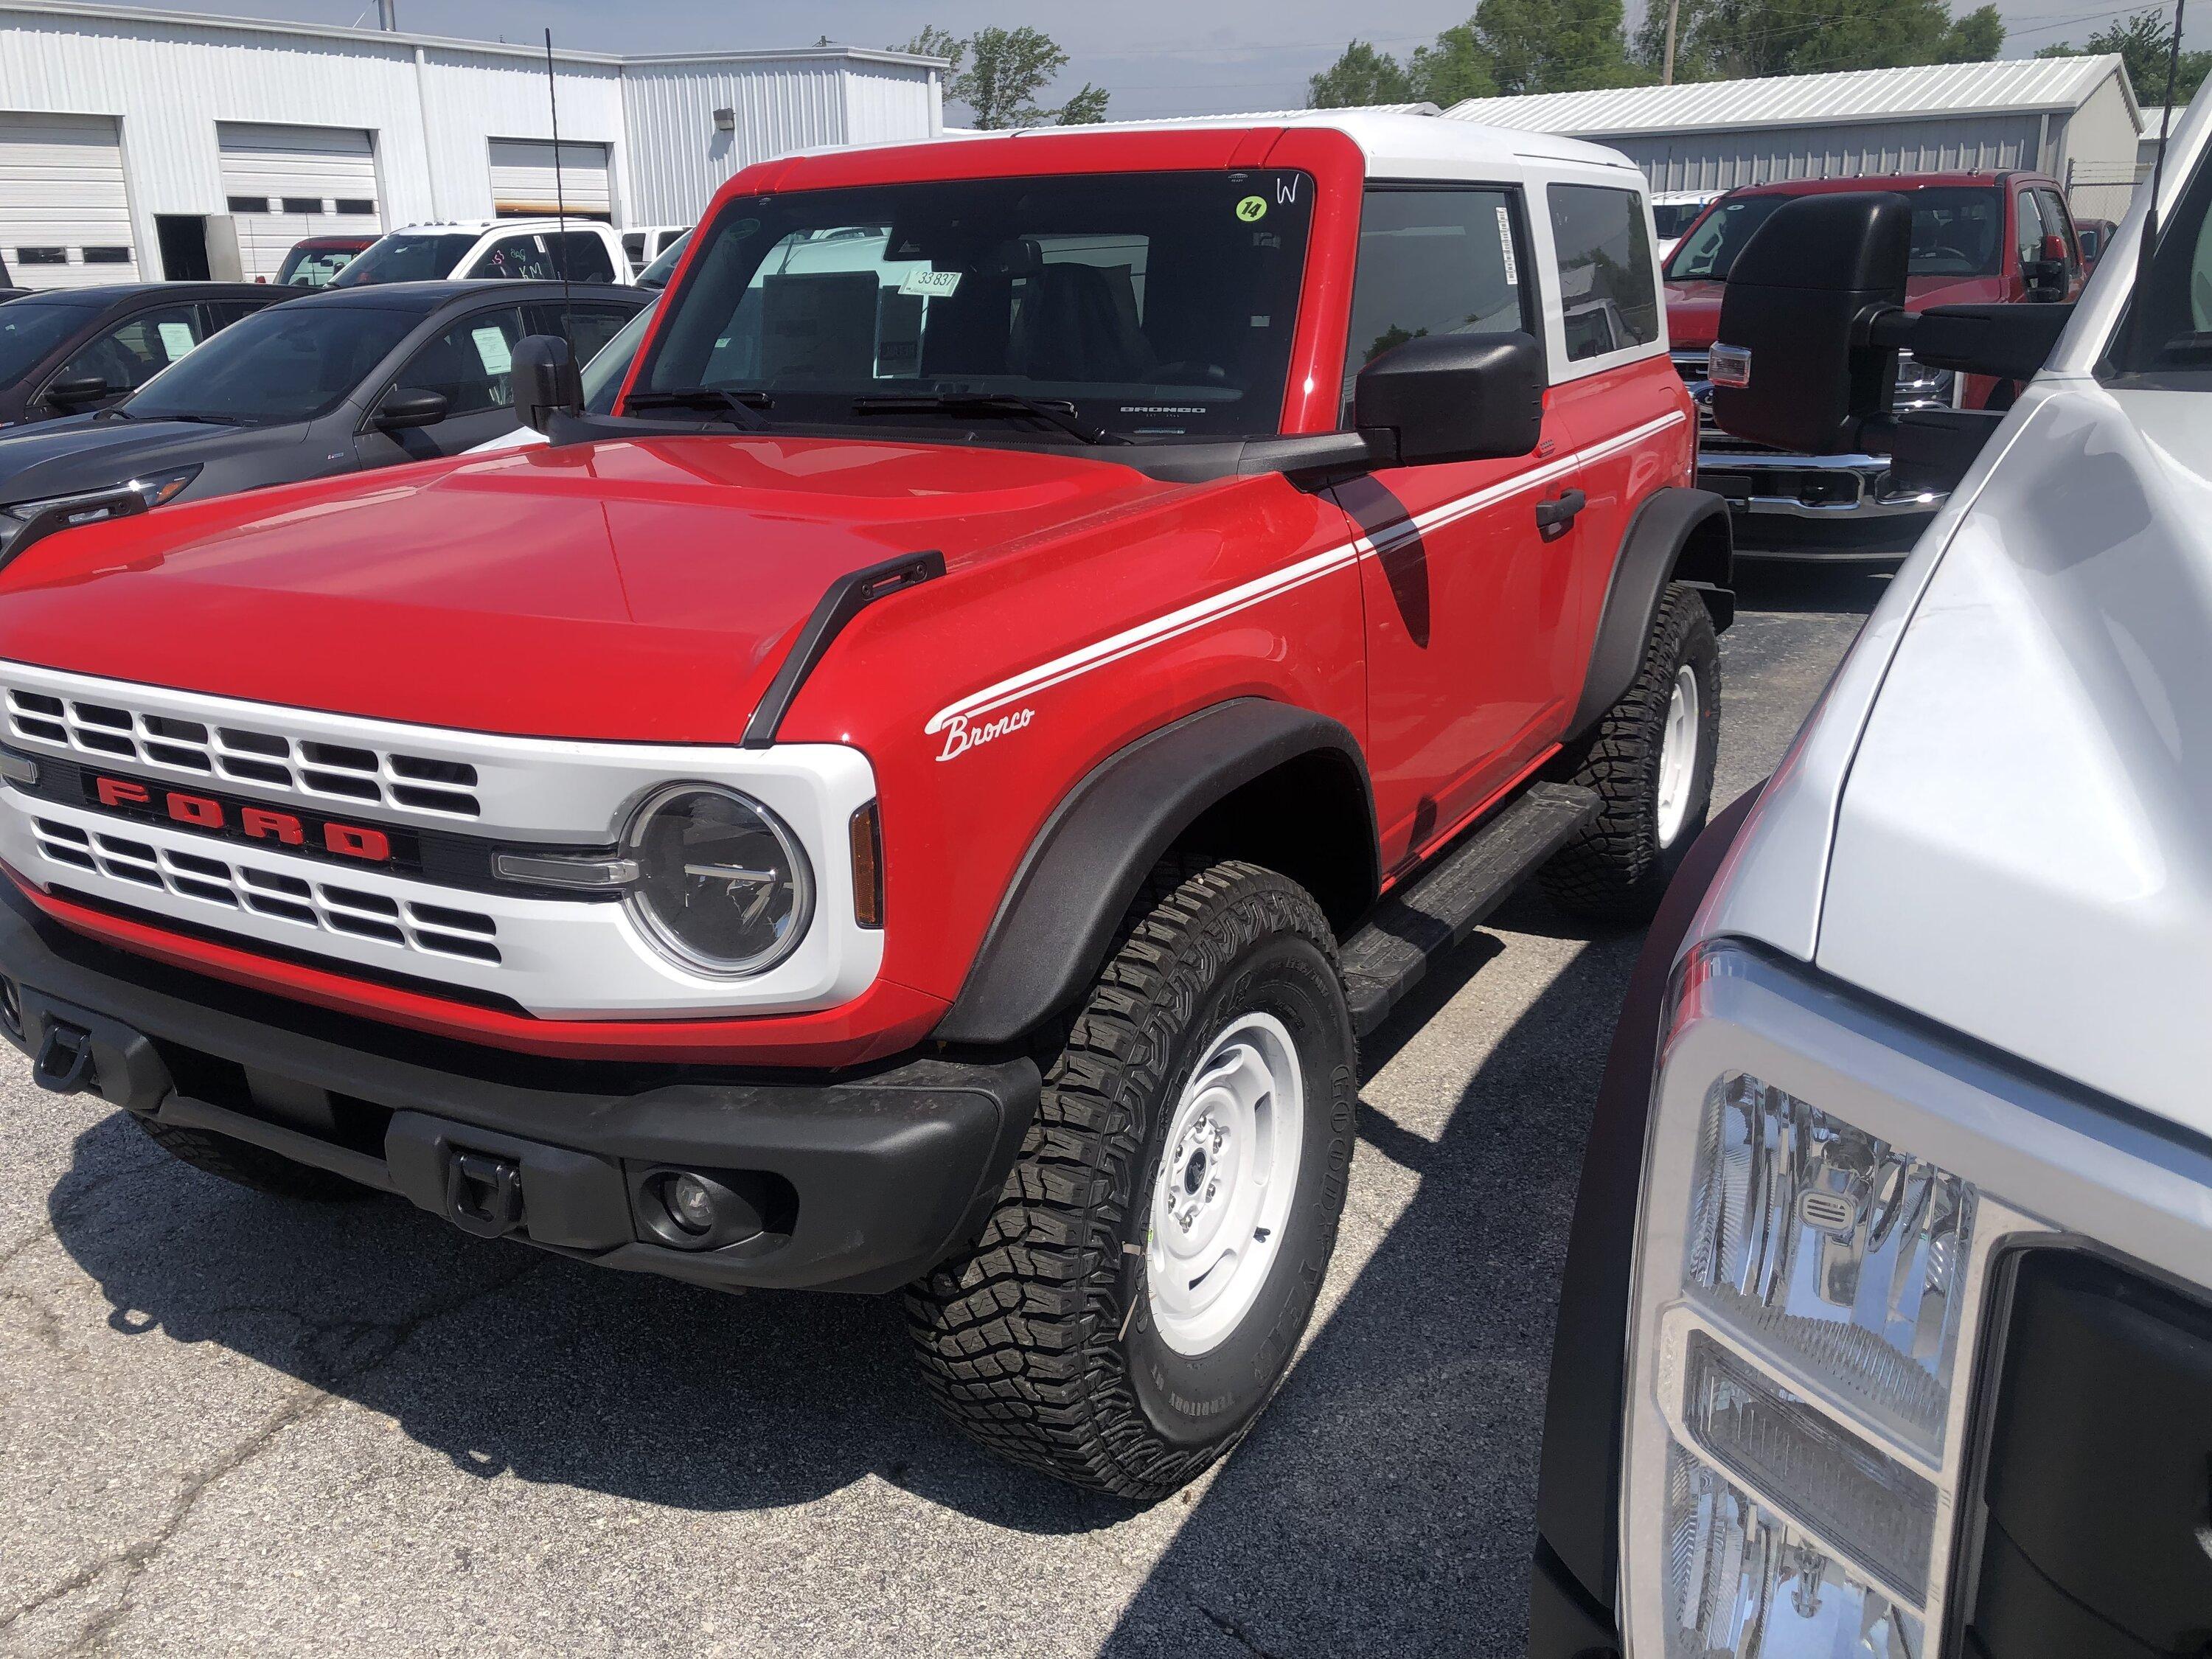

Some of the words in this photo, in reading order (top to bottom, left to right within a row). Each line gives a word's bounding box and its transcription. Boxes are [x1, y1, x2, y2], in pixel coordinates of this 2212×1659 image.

[1242, 201, 1262, 218] 14
[1276, 173, 1299, 204] W
[935, 708, 1035, 762] Bronco
[96, 776, 389, 861] FORD
